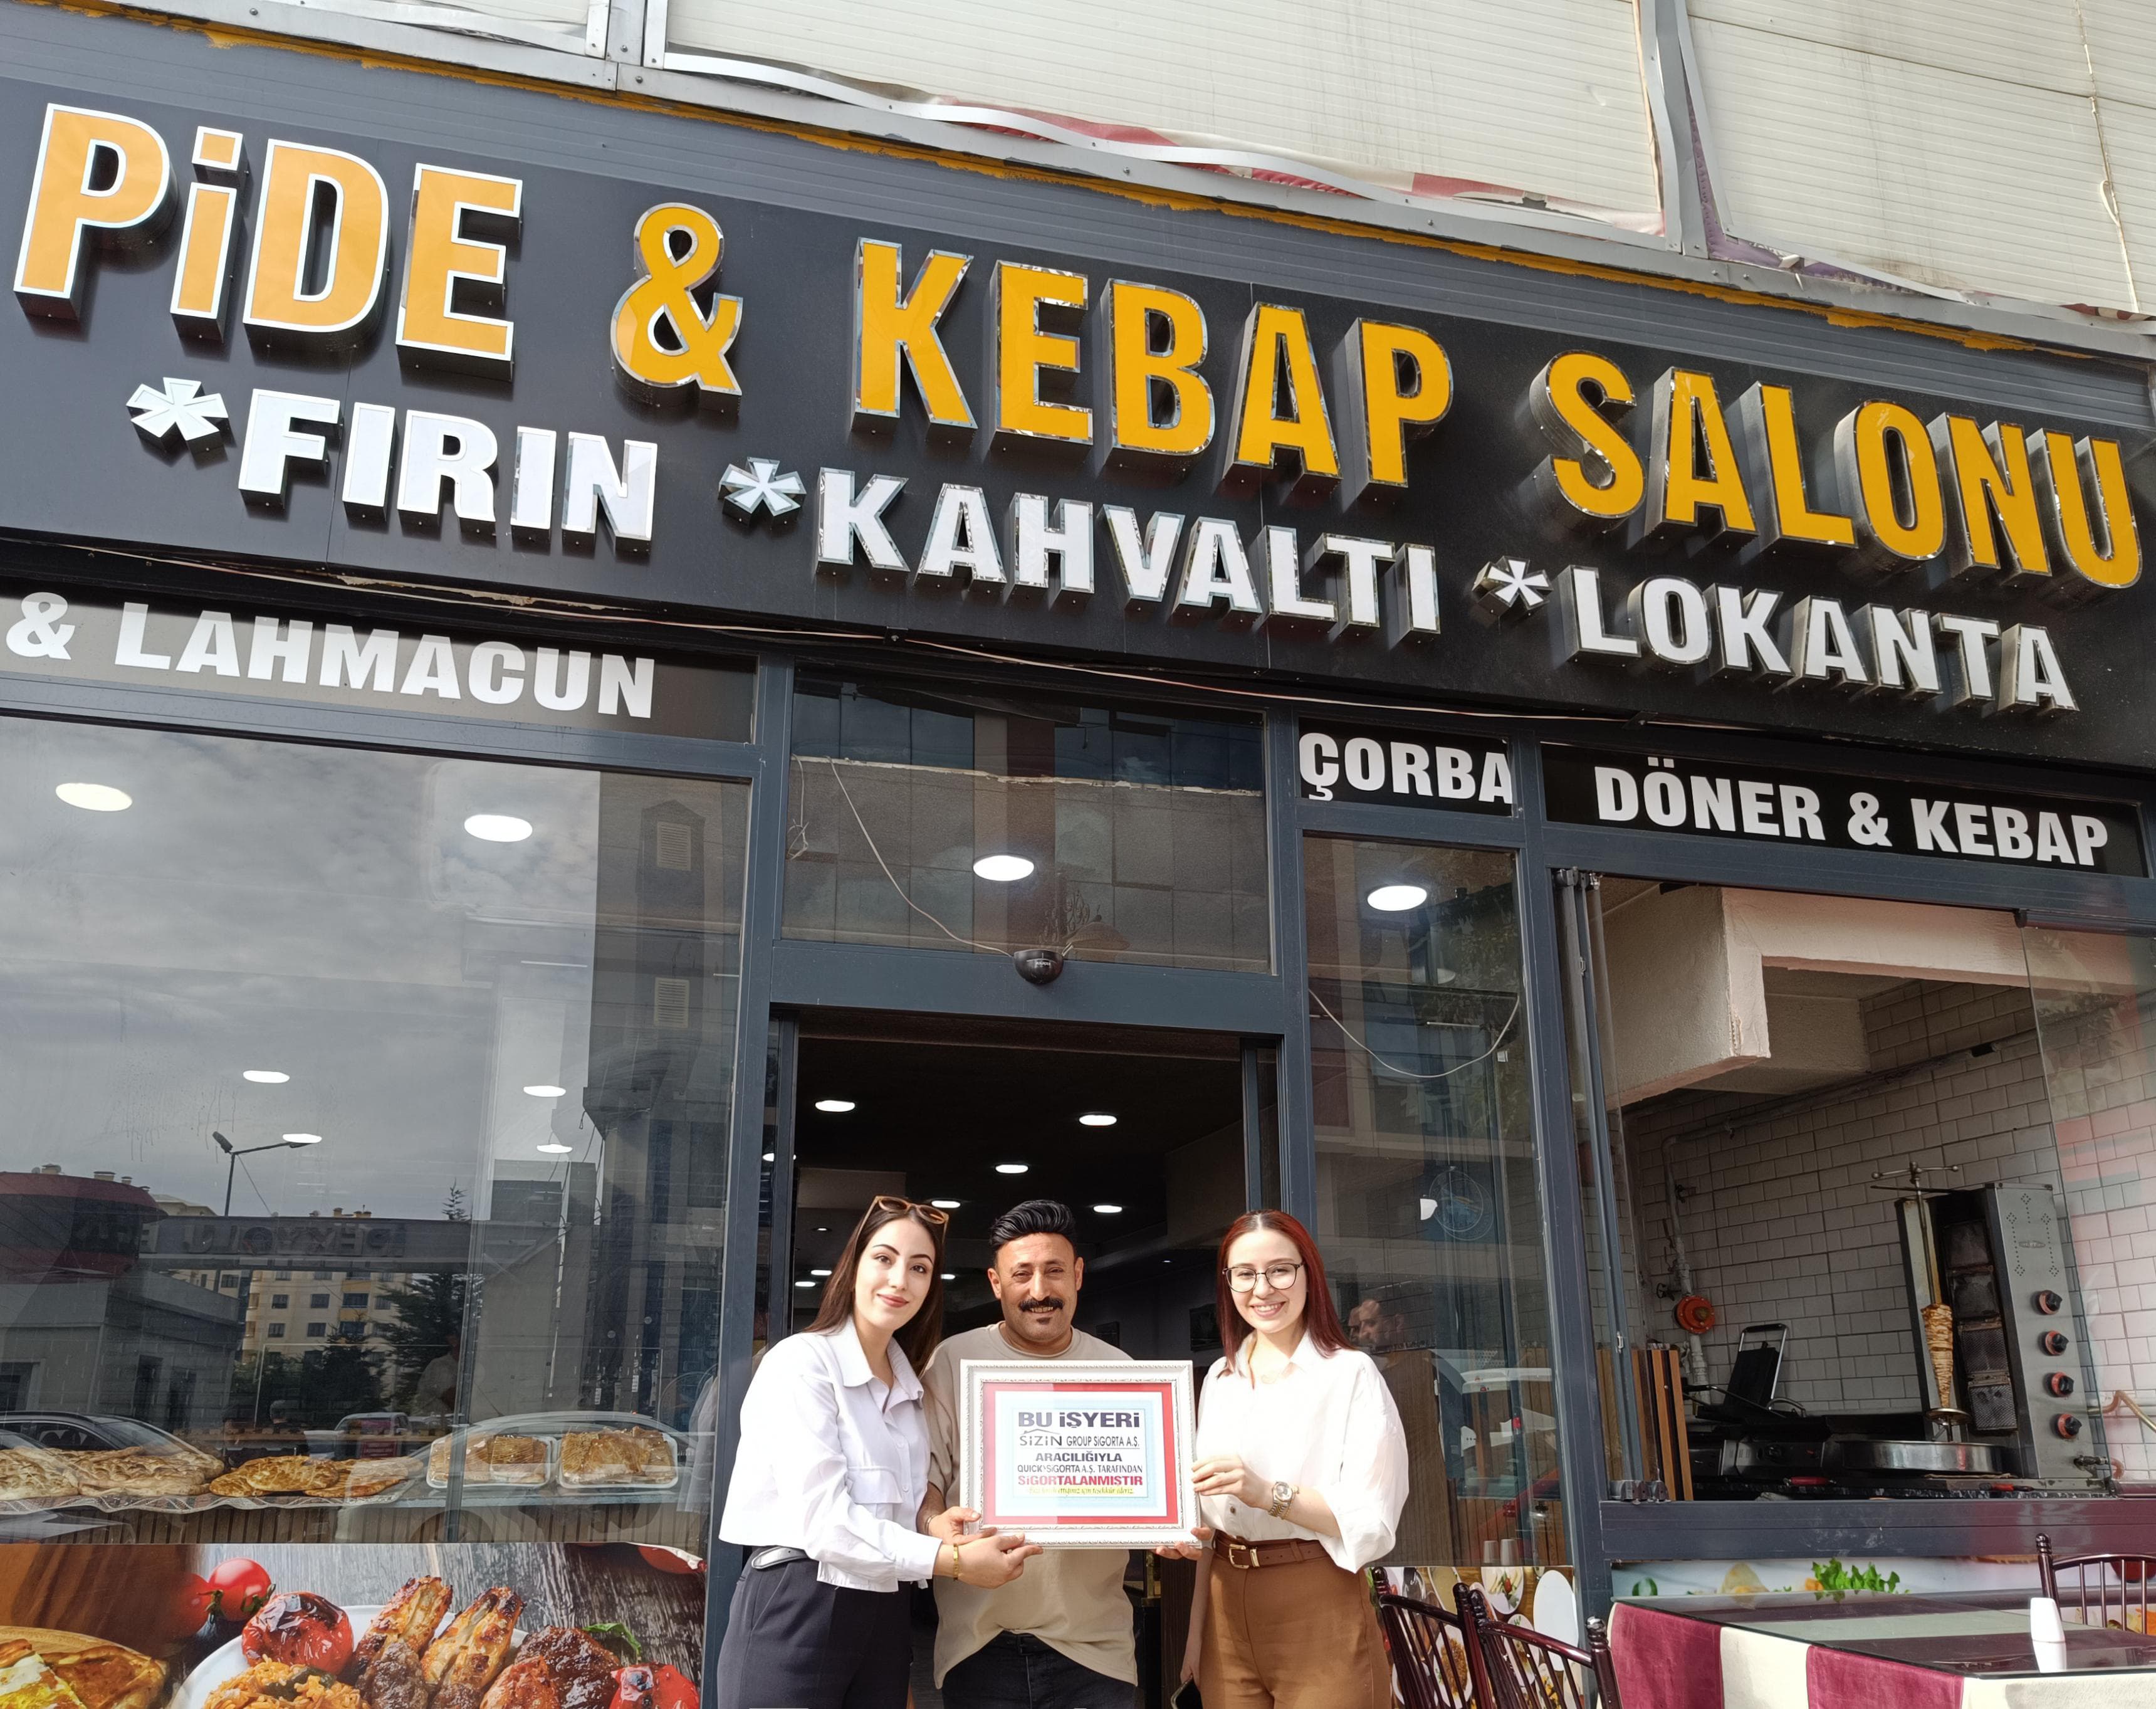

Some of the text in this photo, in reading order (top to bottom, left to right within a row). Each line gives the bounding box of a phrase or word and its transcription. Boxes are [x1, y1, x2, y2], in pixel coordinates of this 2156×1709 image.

[610, 202, 743, 396] &
[854, 238, 1454, 489] KEBAP
[1534, 350, 2143, 589] SALONU
[6, 592, 656, 719] & LAHMACUN
[1299, 732, 1513, 804] ÇORBA
[1594, 757, 2108, 866] DÖNER & KEBAP
[1018, 1412, 1052, 1428] BU
[1067, 1436, 1092, 1446] GROUP
[1035, 1451, 1122, 1462] ARACILIĞIYLA
[1097, 1464, 1143, 1473] TARAFINDAN
